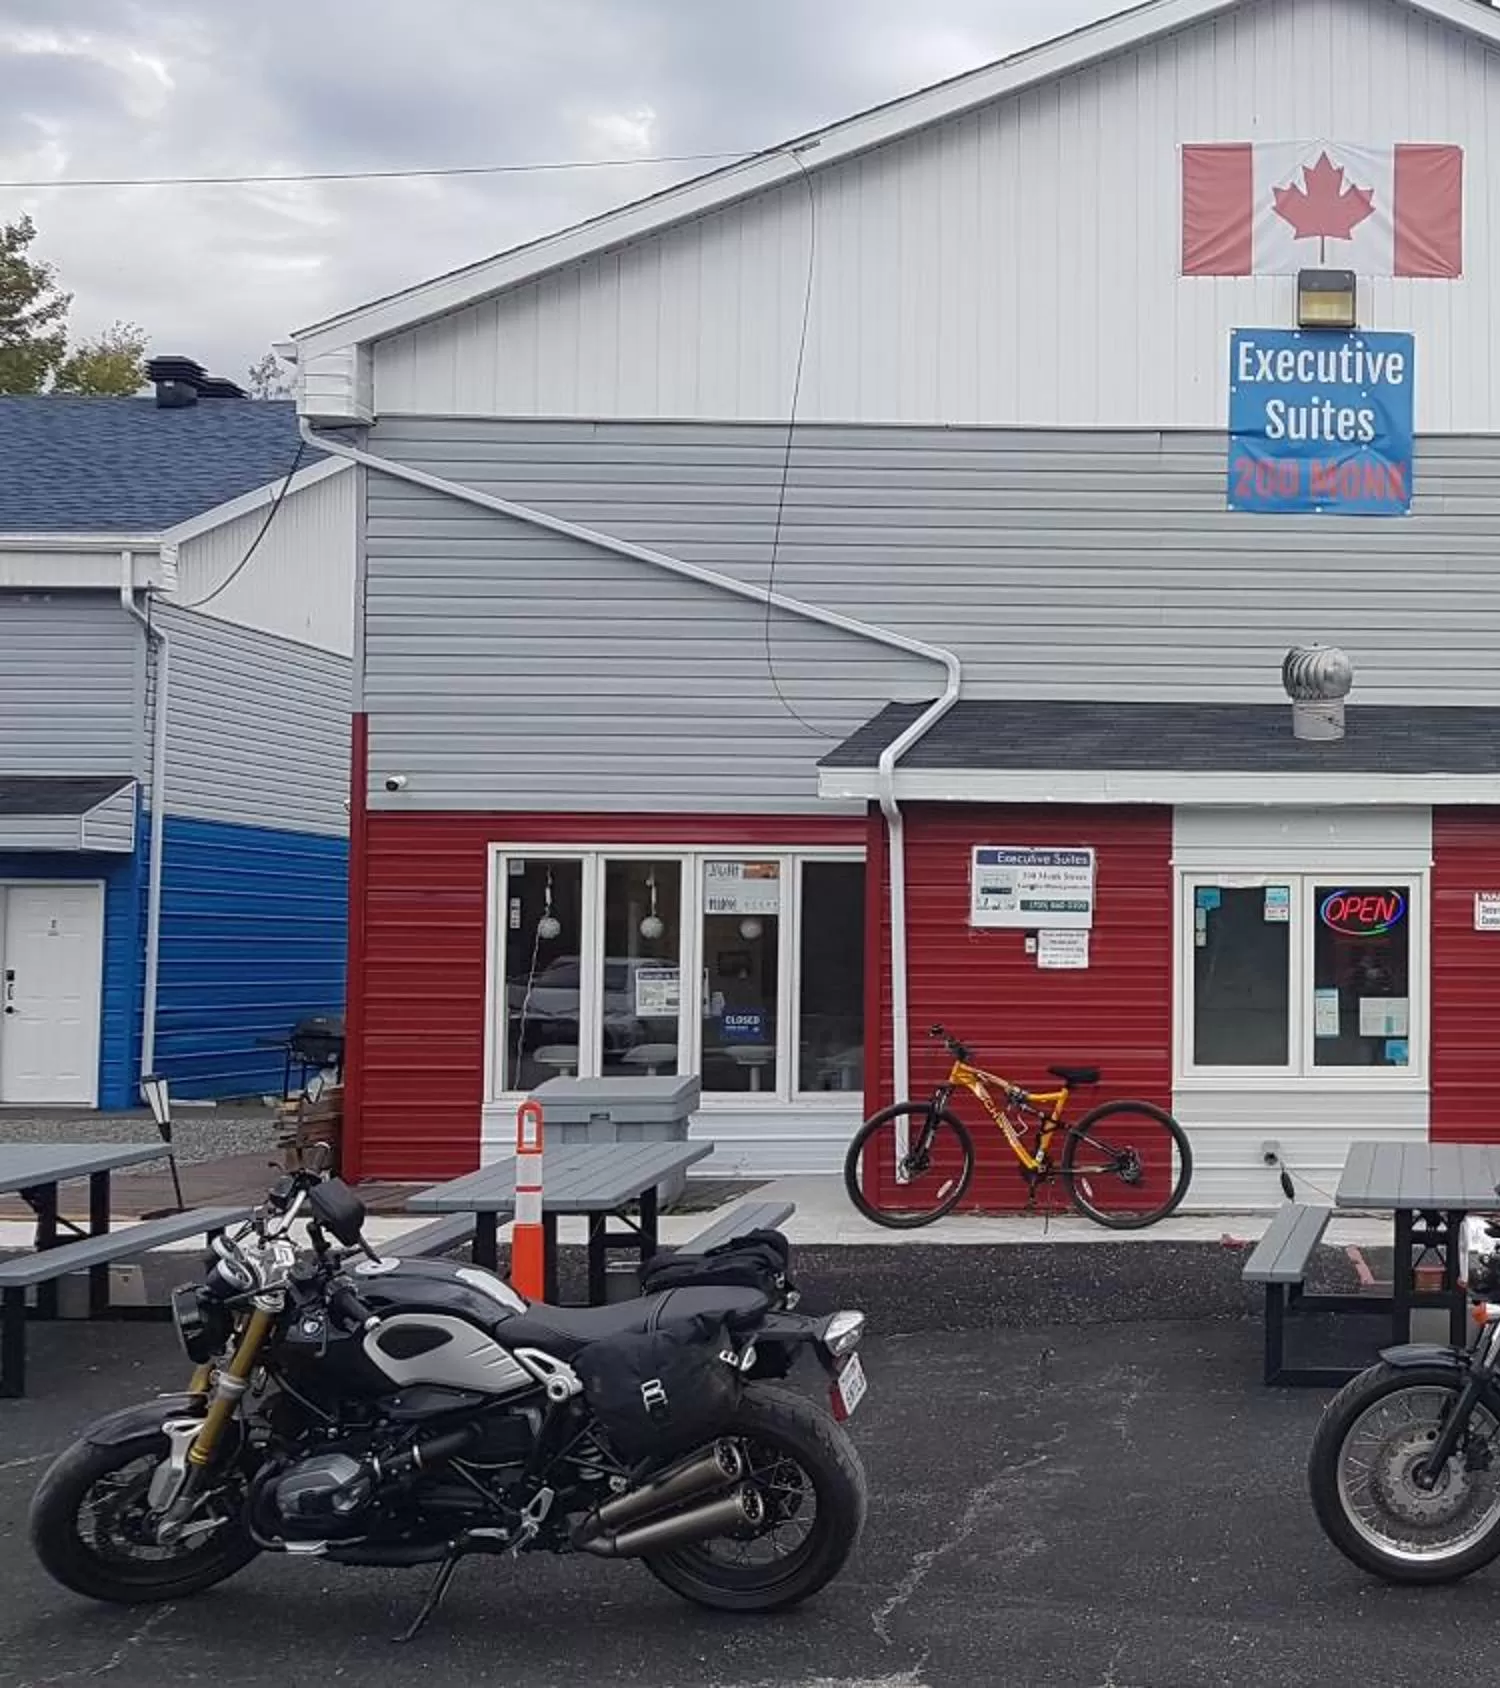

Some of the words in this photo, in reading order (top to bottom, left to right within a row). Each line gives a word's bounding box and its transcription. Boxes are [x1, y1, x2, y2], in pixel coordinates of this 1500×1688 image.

[1238, 341, 1405, 385] Executive
[1265, 396, 1376, 441] Suites
[1234, 457, 1300, 499] 200
[997, 852, 1050, 866] Executive
[1053, 853, 1089, 866] Suites
[1326, 896, 1396, 922] OPEN
